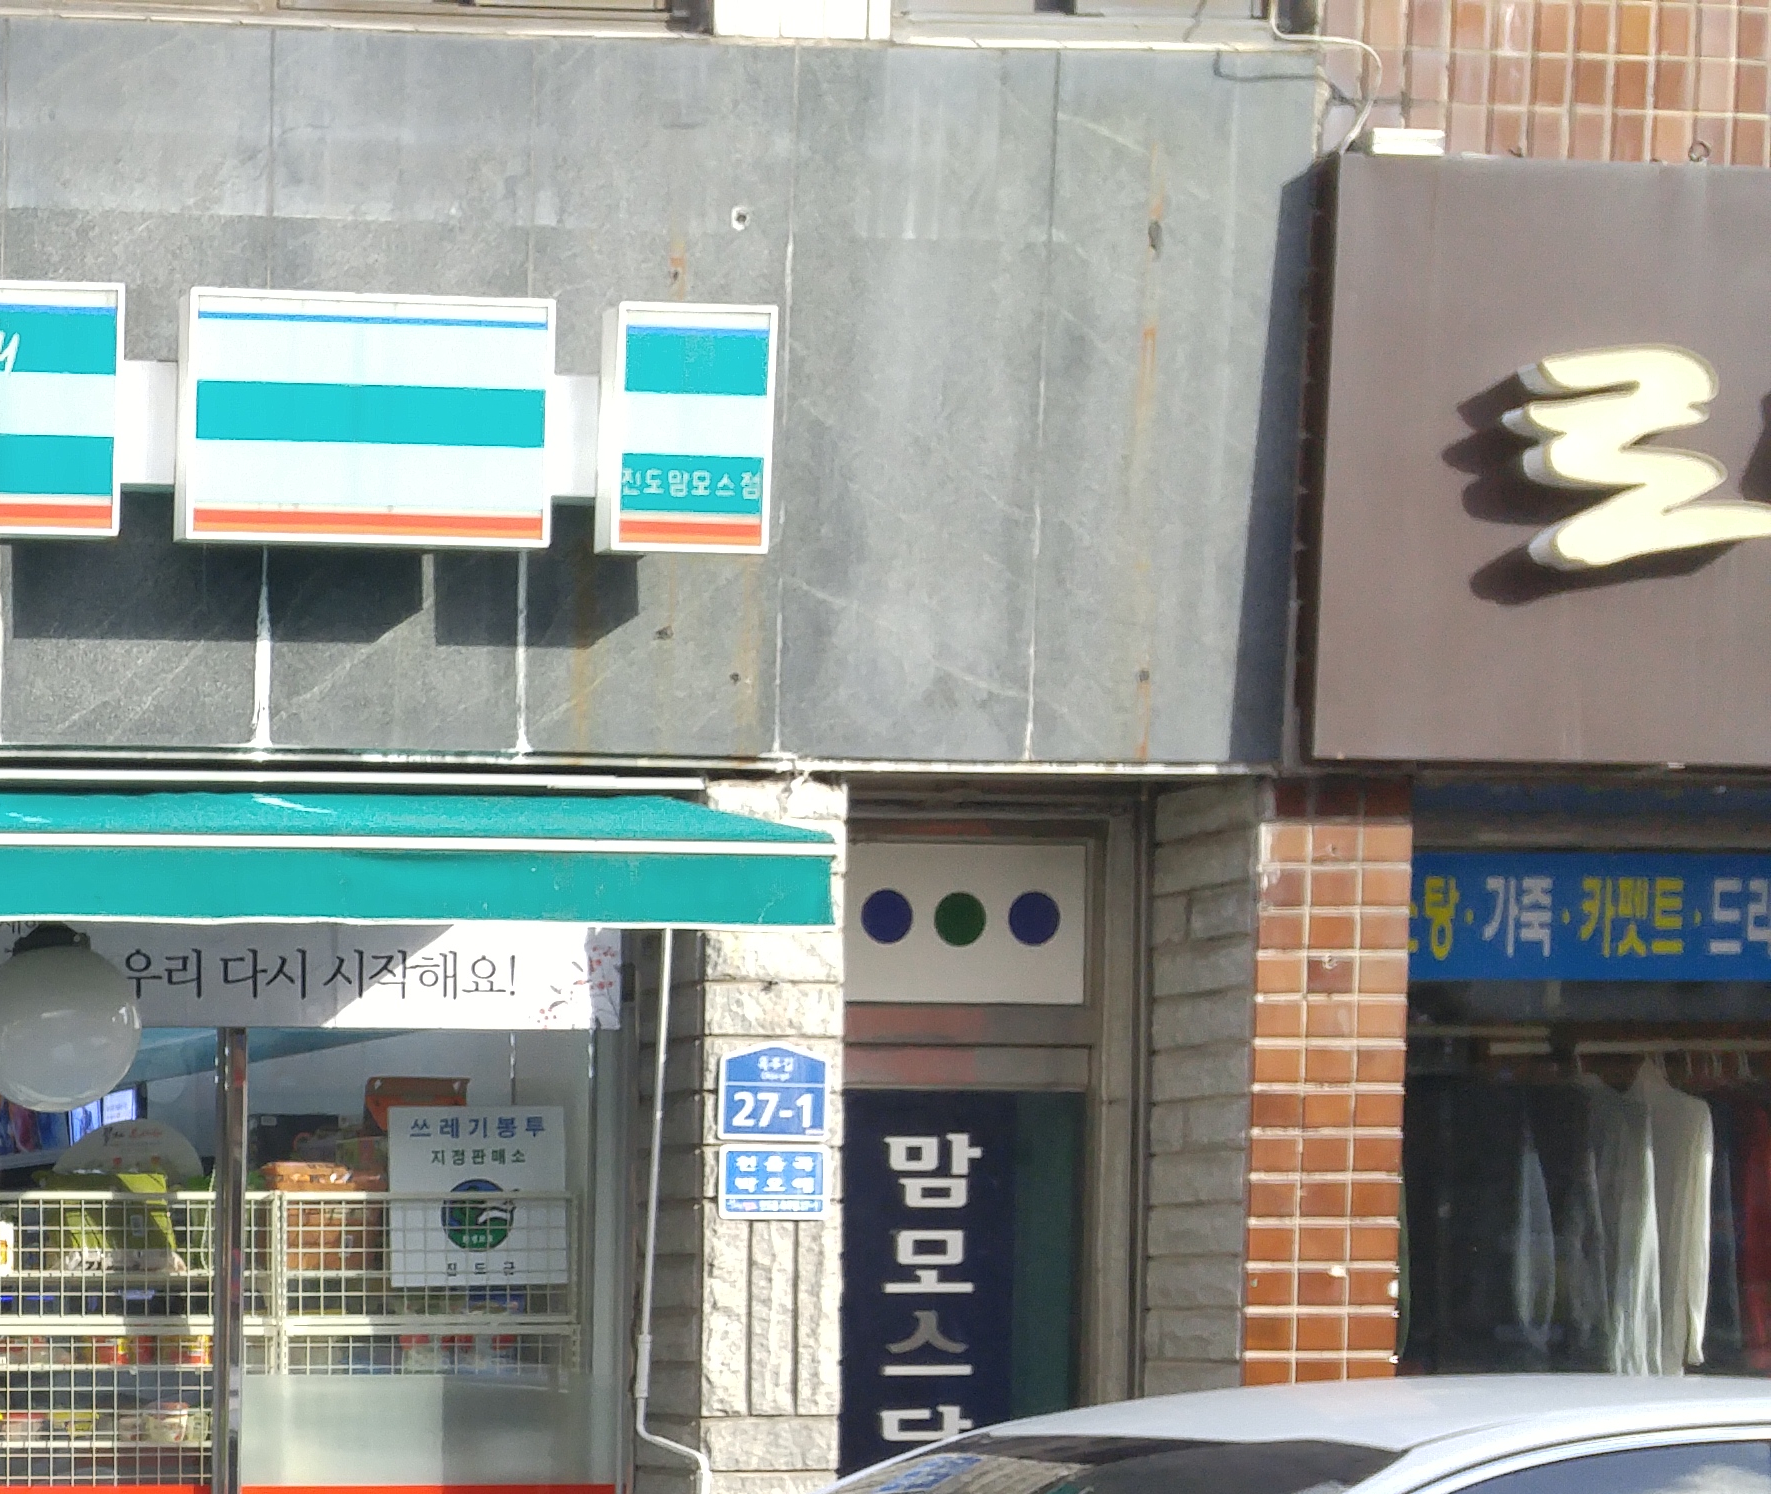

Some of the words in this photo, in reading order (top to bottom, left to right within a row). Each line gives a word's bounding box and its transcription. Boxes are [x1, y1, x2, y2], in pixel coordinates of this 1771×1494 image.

[621, 467, 762, 501] 진도맘모스점
[1481, 876, 1554, 959] 가죽
[124, 948, 203, 1000] 우리
[219, 948, 309, 1000] 다시
[322, 948, 517, 1001] 시작해요!
[731, 1090, 813, 1128] 27-1
[410, 1116, 545, 1139] 쓰레기봉투
[430, 1149, 526, 1166] 지정판매소
